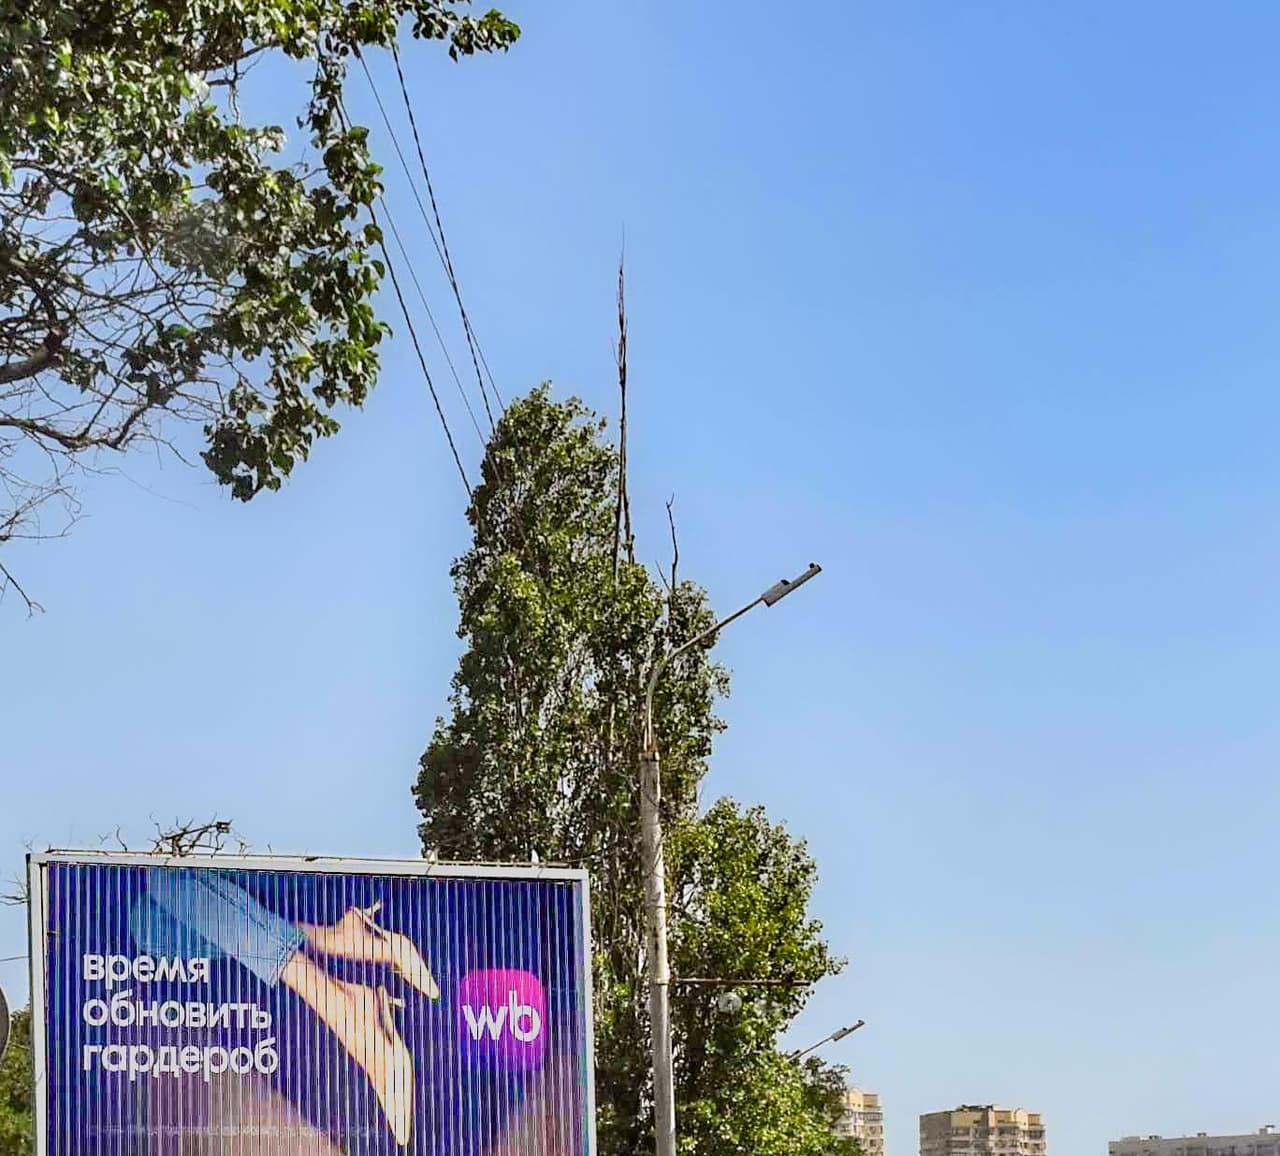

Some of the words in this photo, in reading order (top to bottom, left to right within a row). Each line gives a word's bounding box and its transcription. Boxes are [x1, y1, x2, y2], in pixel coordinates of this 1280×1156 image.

[83, 954, 209, 990] время
[82, 989, 272, 1029] обновить
[462, 989, 542, 1043] wb
[83, 1037, 279, 1082] гардероб
